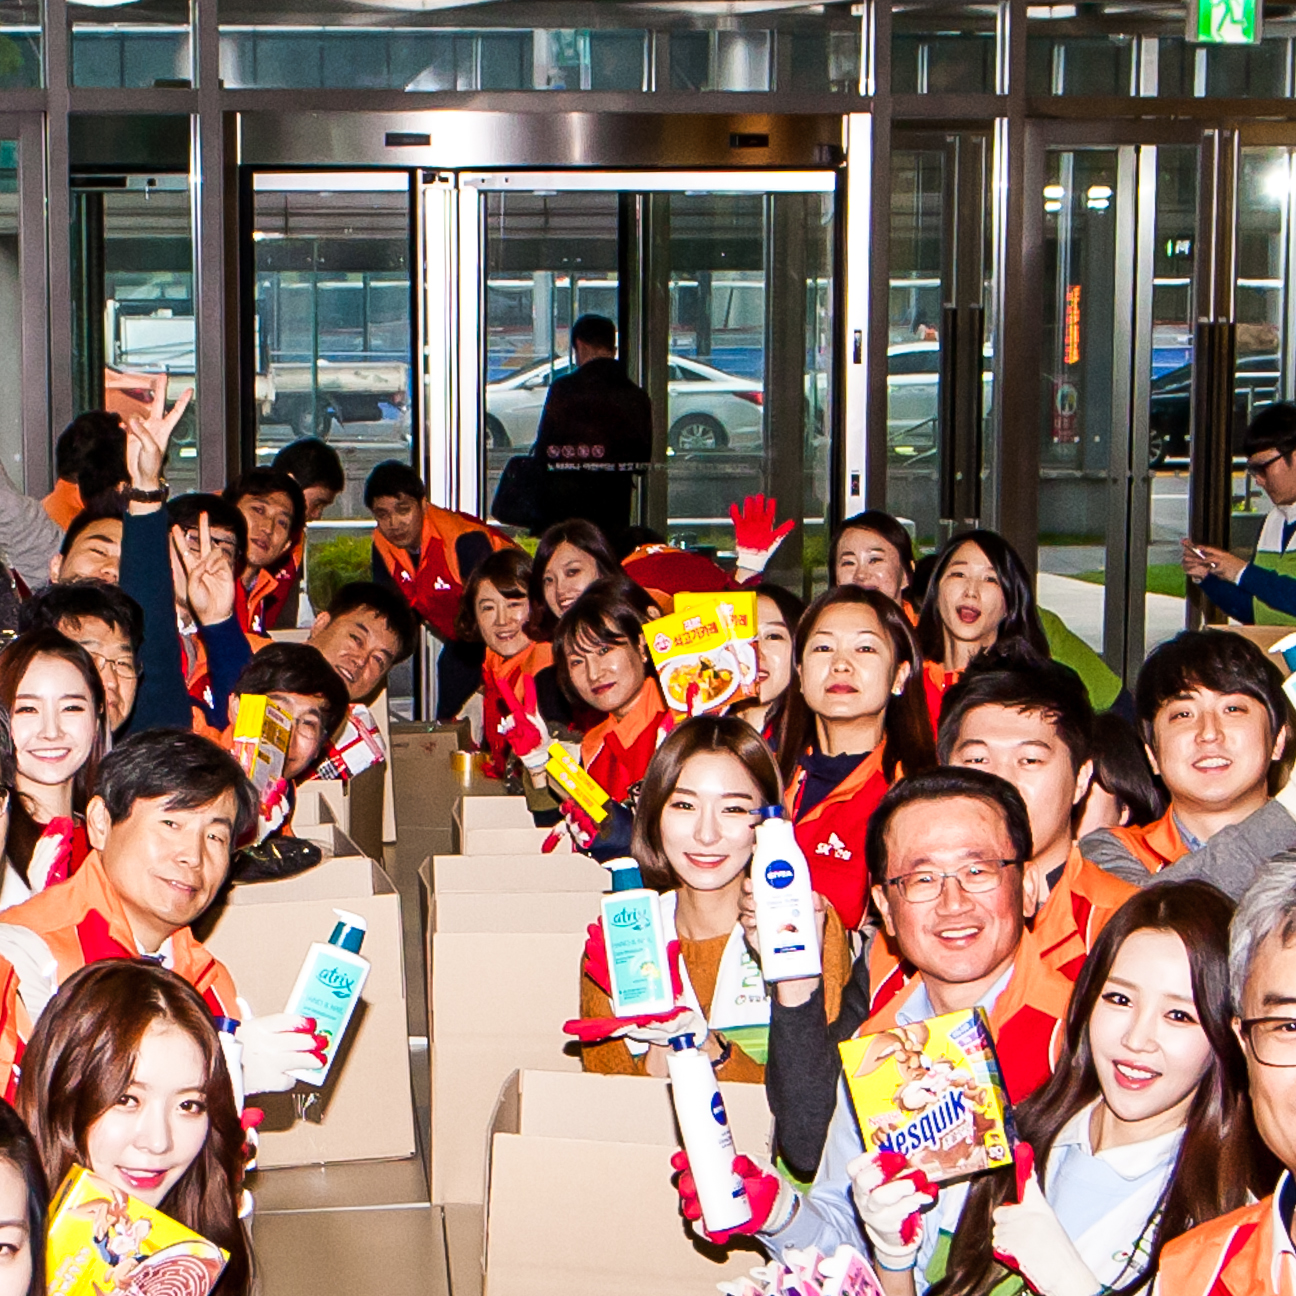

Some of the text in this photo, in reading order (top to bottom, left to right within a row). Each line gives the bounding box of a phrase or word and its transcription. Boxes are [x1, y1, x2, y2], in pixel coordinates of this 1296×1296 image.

[815, 842, 833, 856] SK
[612, 906, 649, 926] atrix
[317, 966, 356, 993] atrix
